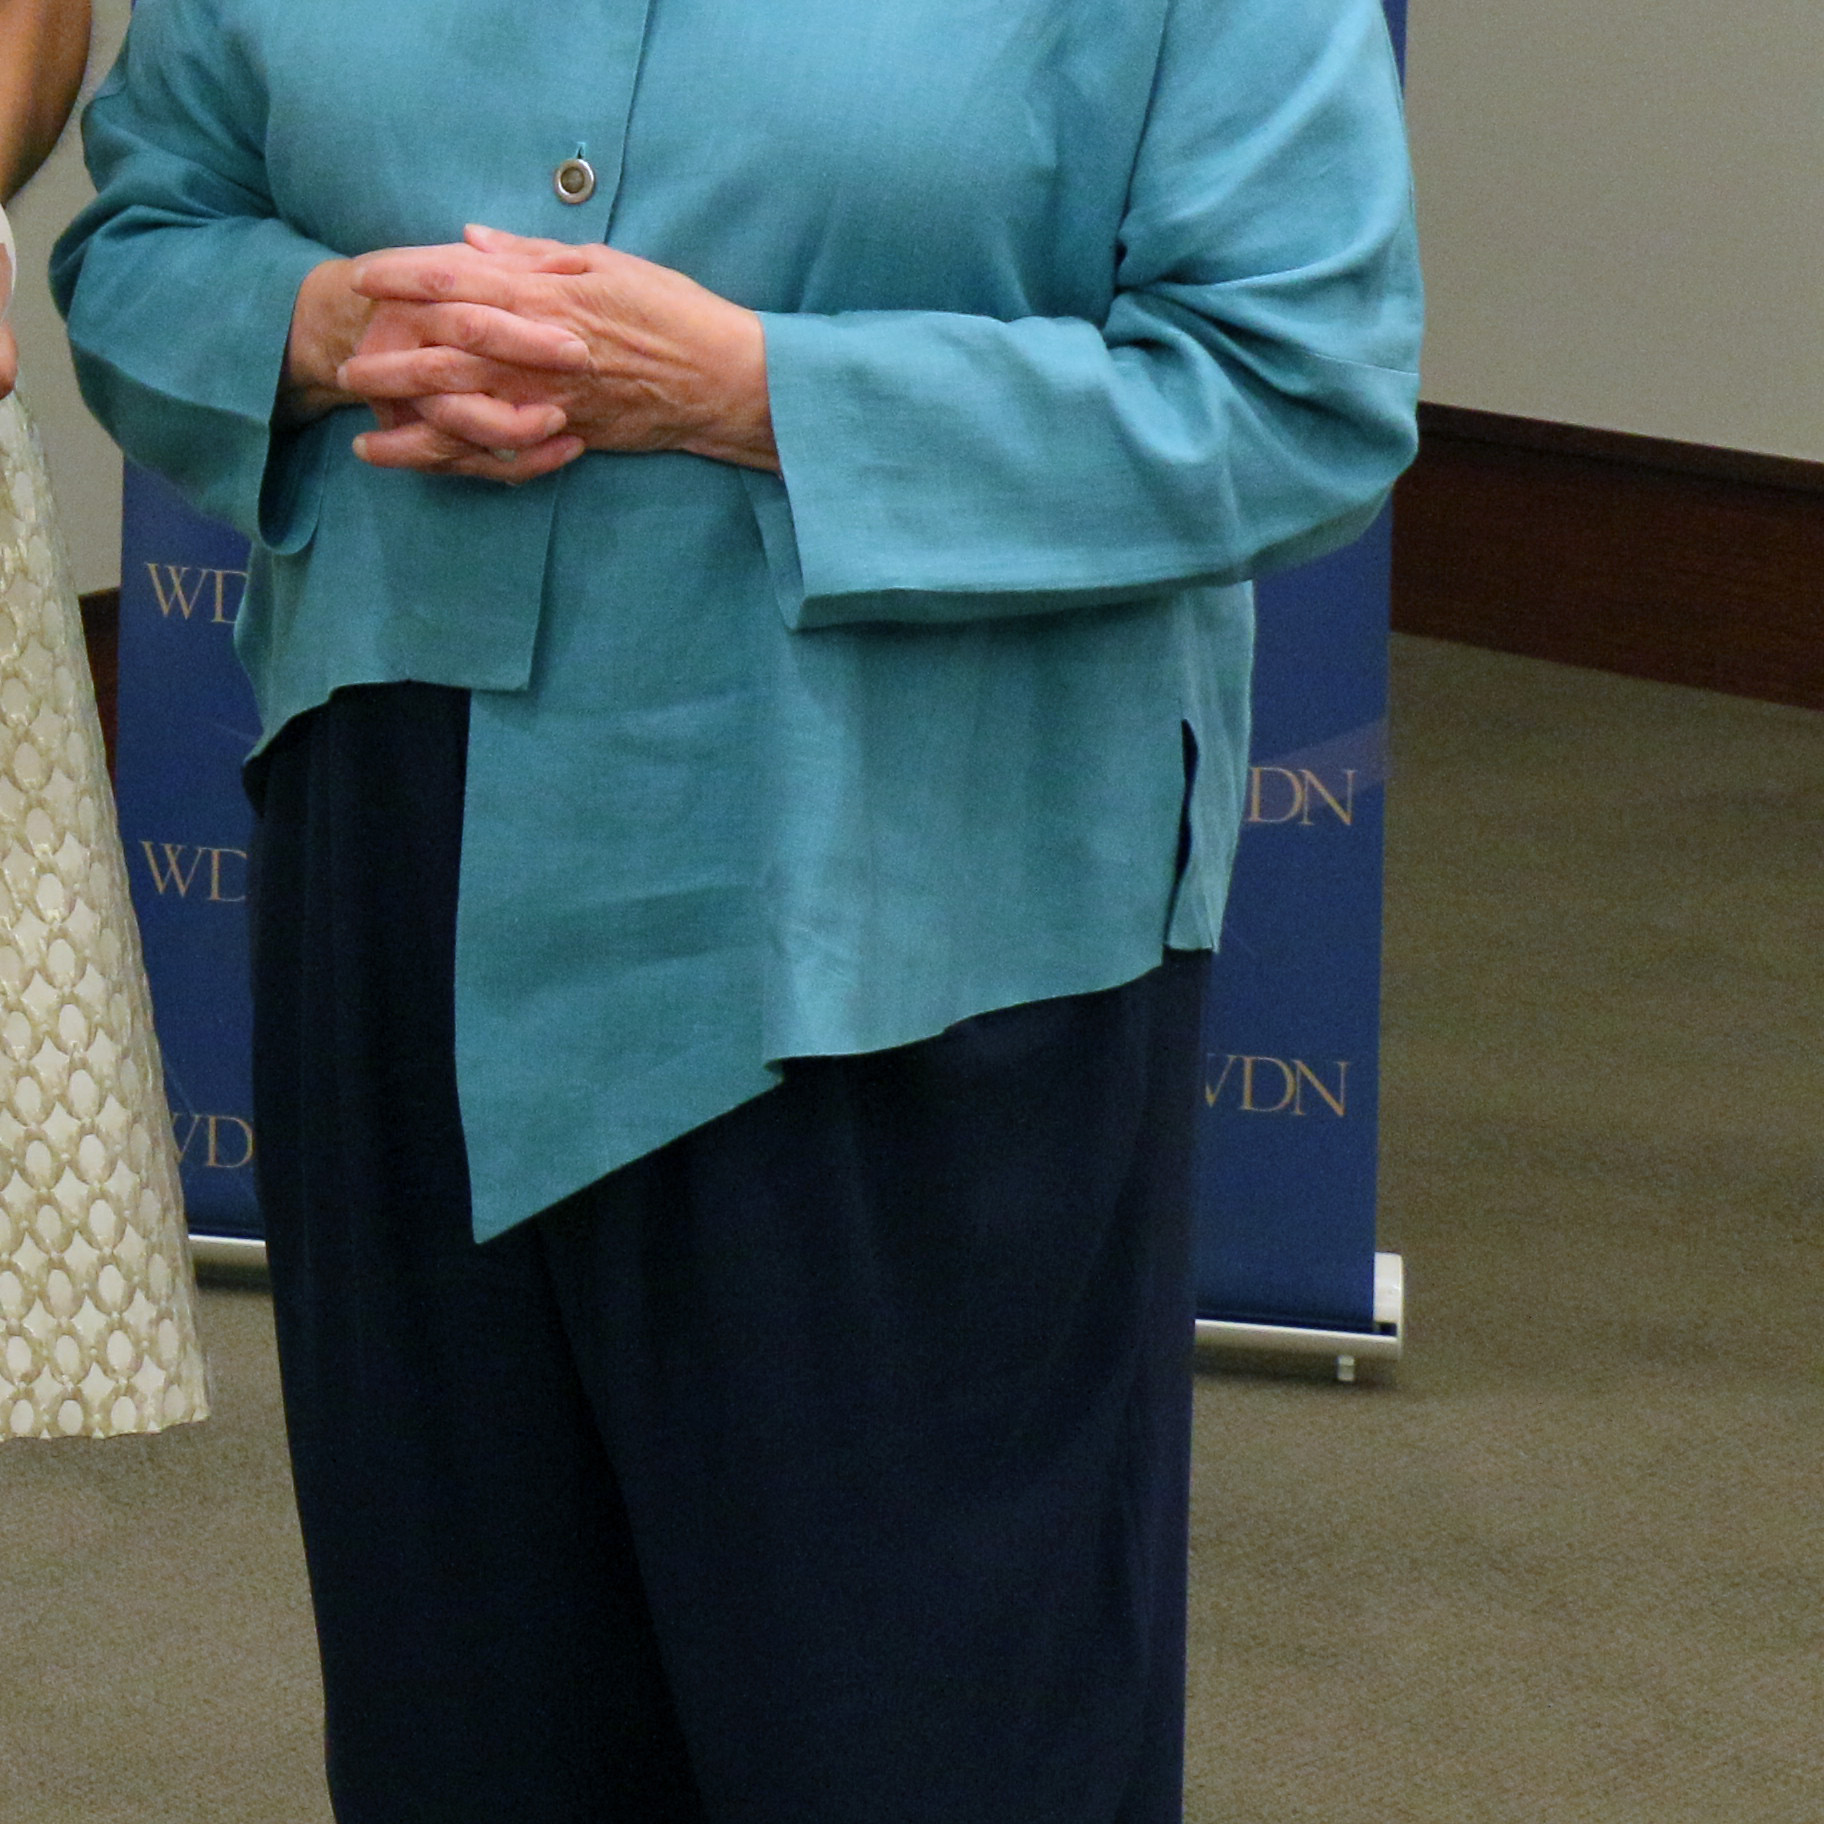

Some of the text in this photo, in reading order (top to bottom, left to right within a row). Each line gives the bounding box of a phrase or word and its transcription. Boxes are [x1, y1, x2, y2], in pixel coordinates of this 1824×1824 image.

[145, 562, 248, 624] WD
[1245, 765, 1358, 826] DN
[139, 840, 248, 902] WD
